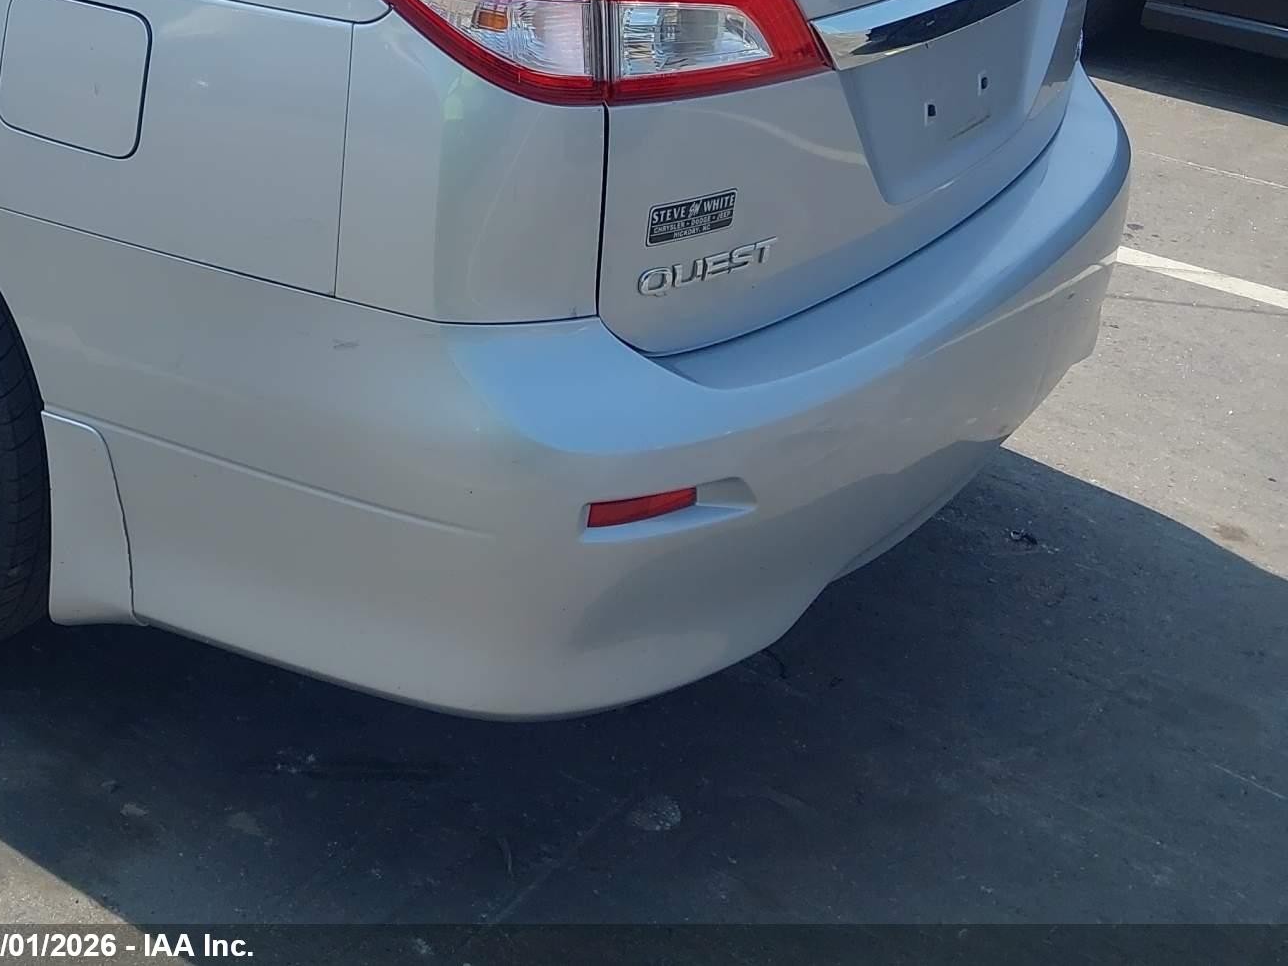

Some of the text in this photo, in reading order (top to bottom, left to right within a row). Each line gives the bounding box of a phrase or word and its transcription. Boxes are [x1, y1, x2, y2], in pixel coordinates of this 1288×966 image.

[652, 206, 686, 224] STEVE
[703, 194, 735, 212] WHITE
[653, 211, 731, 234] CHRYSLER DODGE JEEP
[638, 236, 777, 297] QUEST
